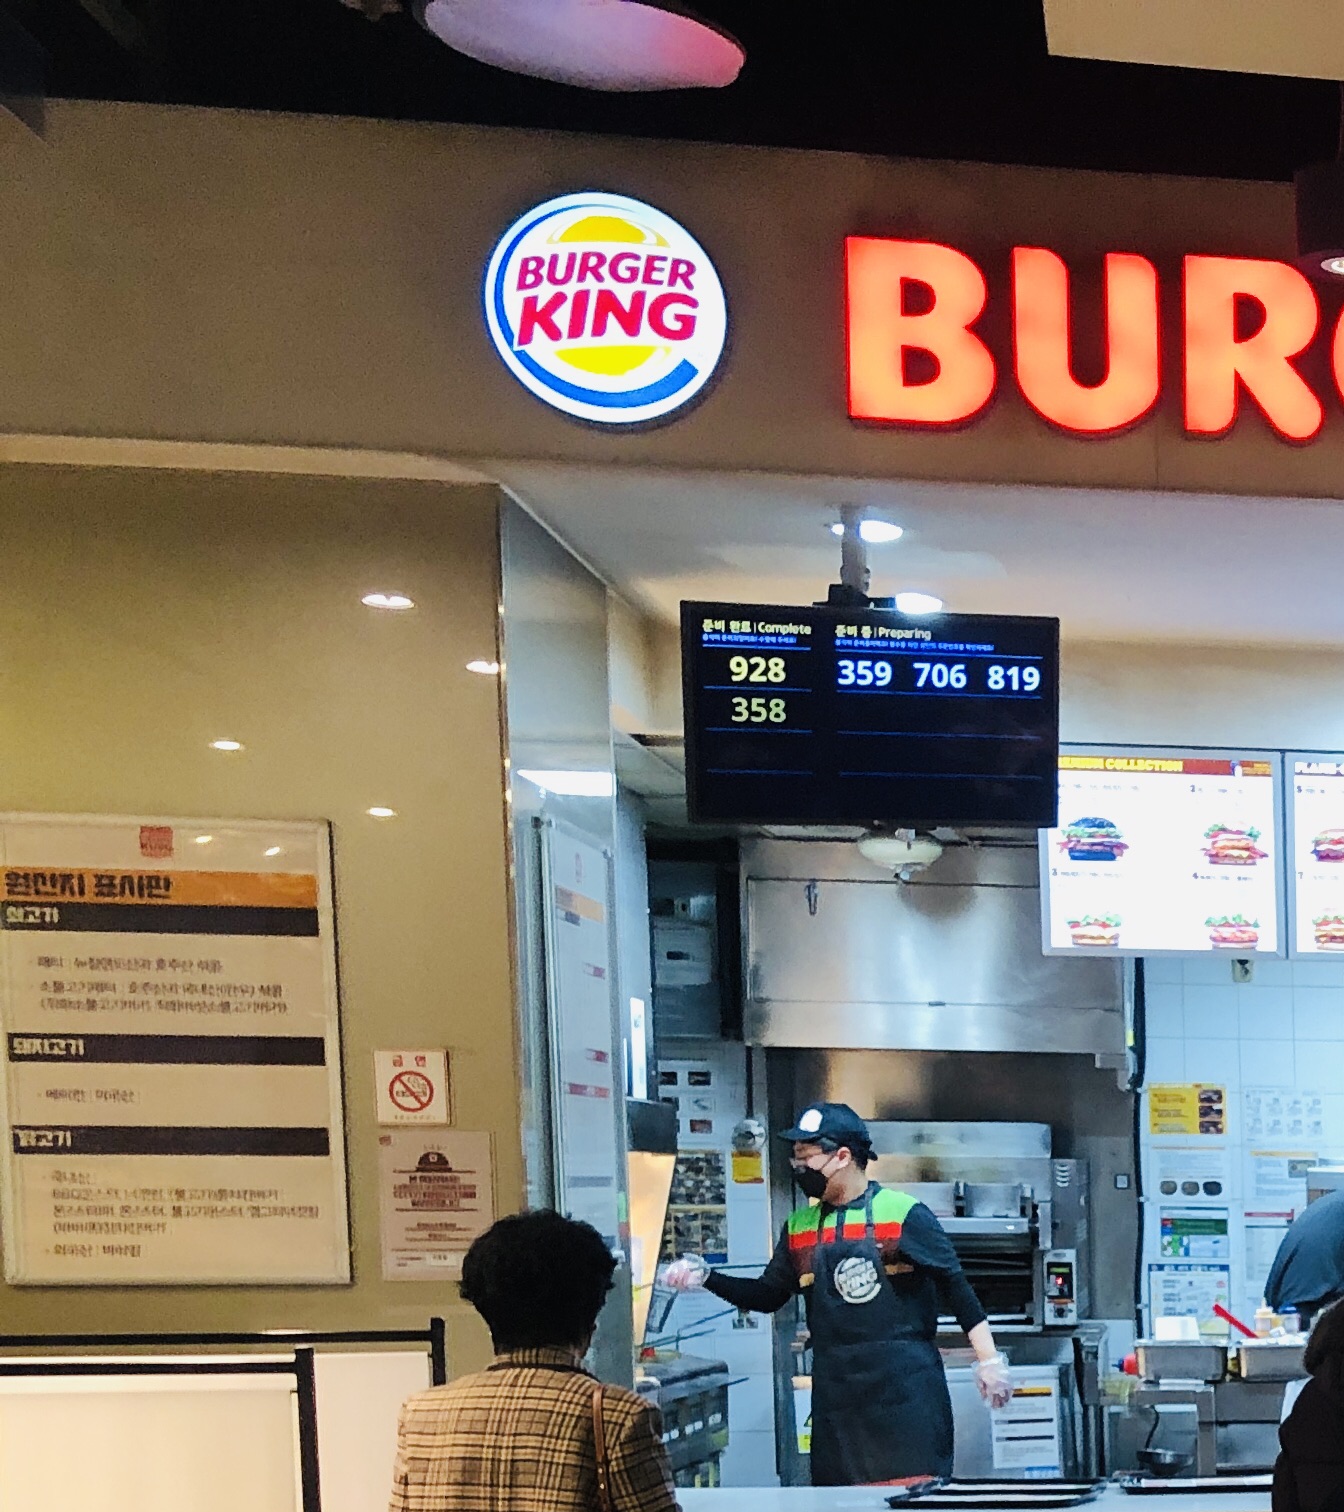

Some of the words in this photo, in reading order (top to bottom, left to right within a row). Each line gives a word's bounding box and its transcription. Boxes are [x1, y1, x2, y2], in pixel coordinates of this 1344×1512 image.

[517, 251, 696, 292] BURGER
[515, 288, 700, 346] KING
[757, 621, 812, 635] Complete
[878, 627, 932, 641] Preparing
[729, 656, 786, 683] 928
[837, 660, 893, 686] 359
[913, 662, 967, 689] 706
[987, 665, 1041, 691] 819
[731, 697, 786, 723] 358
[5, 871, 86, 897] 원산지
[93, 872, 173, 898] 표시판
